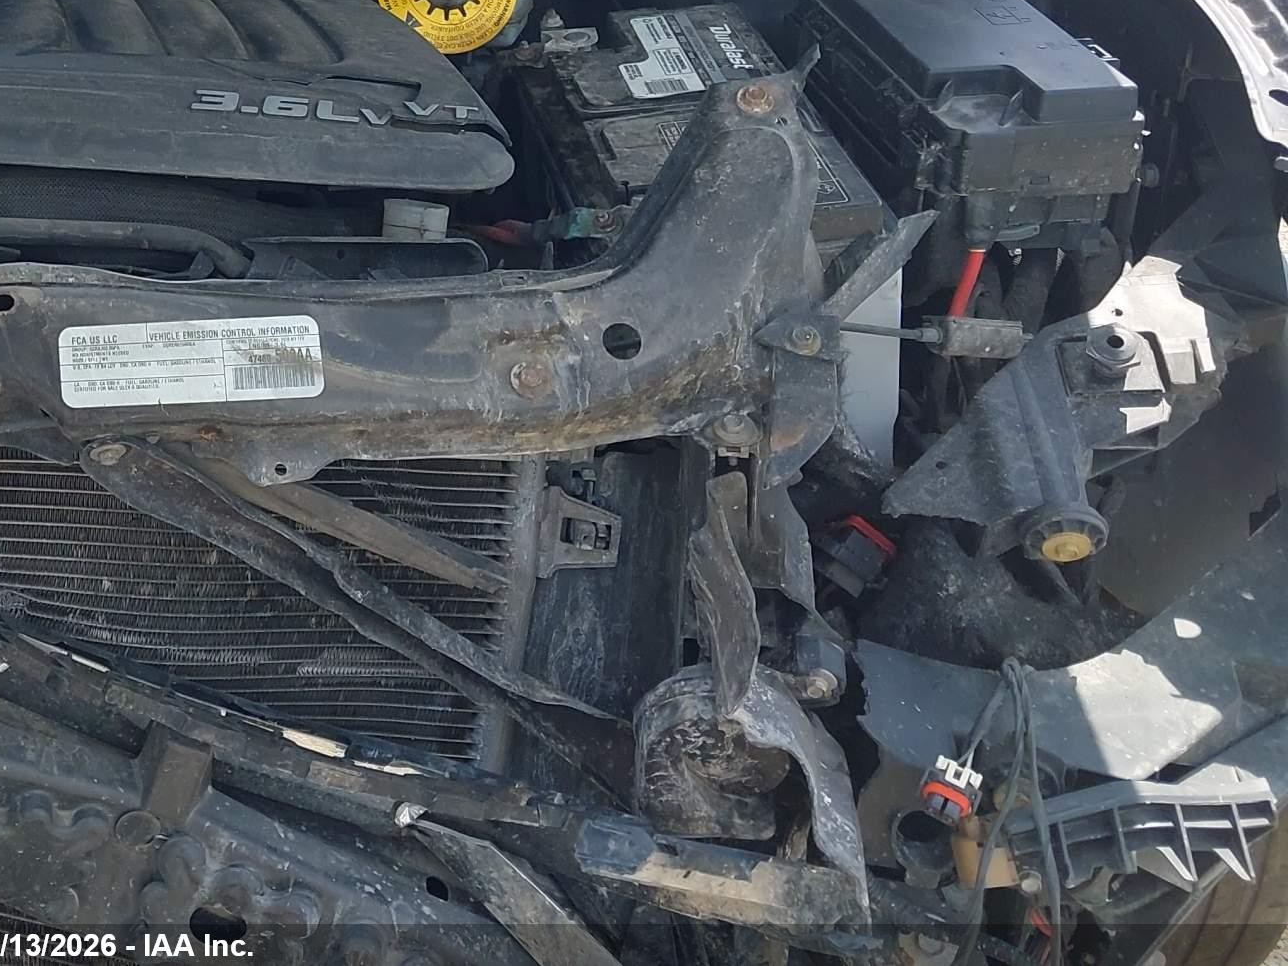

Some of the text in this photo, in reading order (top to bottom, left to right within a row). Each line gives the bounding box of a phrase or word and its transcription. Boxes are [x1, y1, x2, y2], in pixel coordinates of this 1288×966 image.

[708, 24, 754, 71] Duralast
[191, 89, 360, 124] 3.6L
[72, 334, 118, 345] FCA US LLC
[149, 331, 180, 342] VEHICLE
[182, 329, 219, 340] EMISSION
[221, 327, 256, 338] CONTROL
[258, 325, 310, 336] INFORMATION
